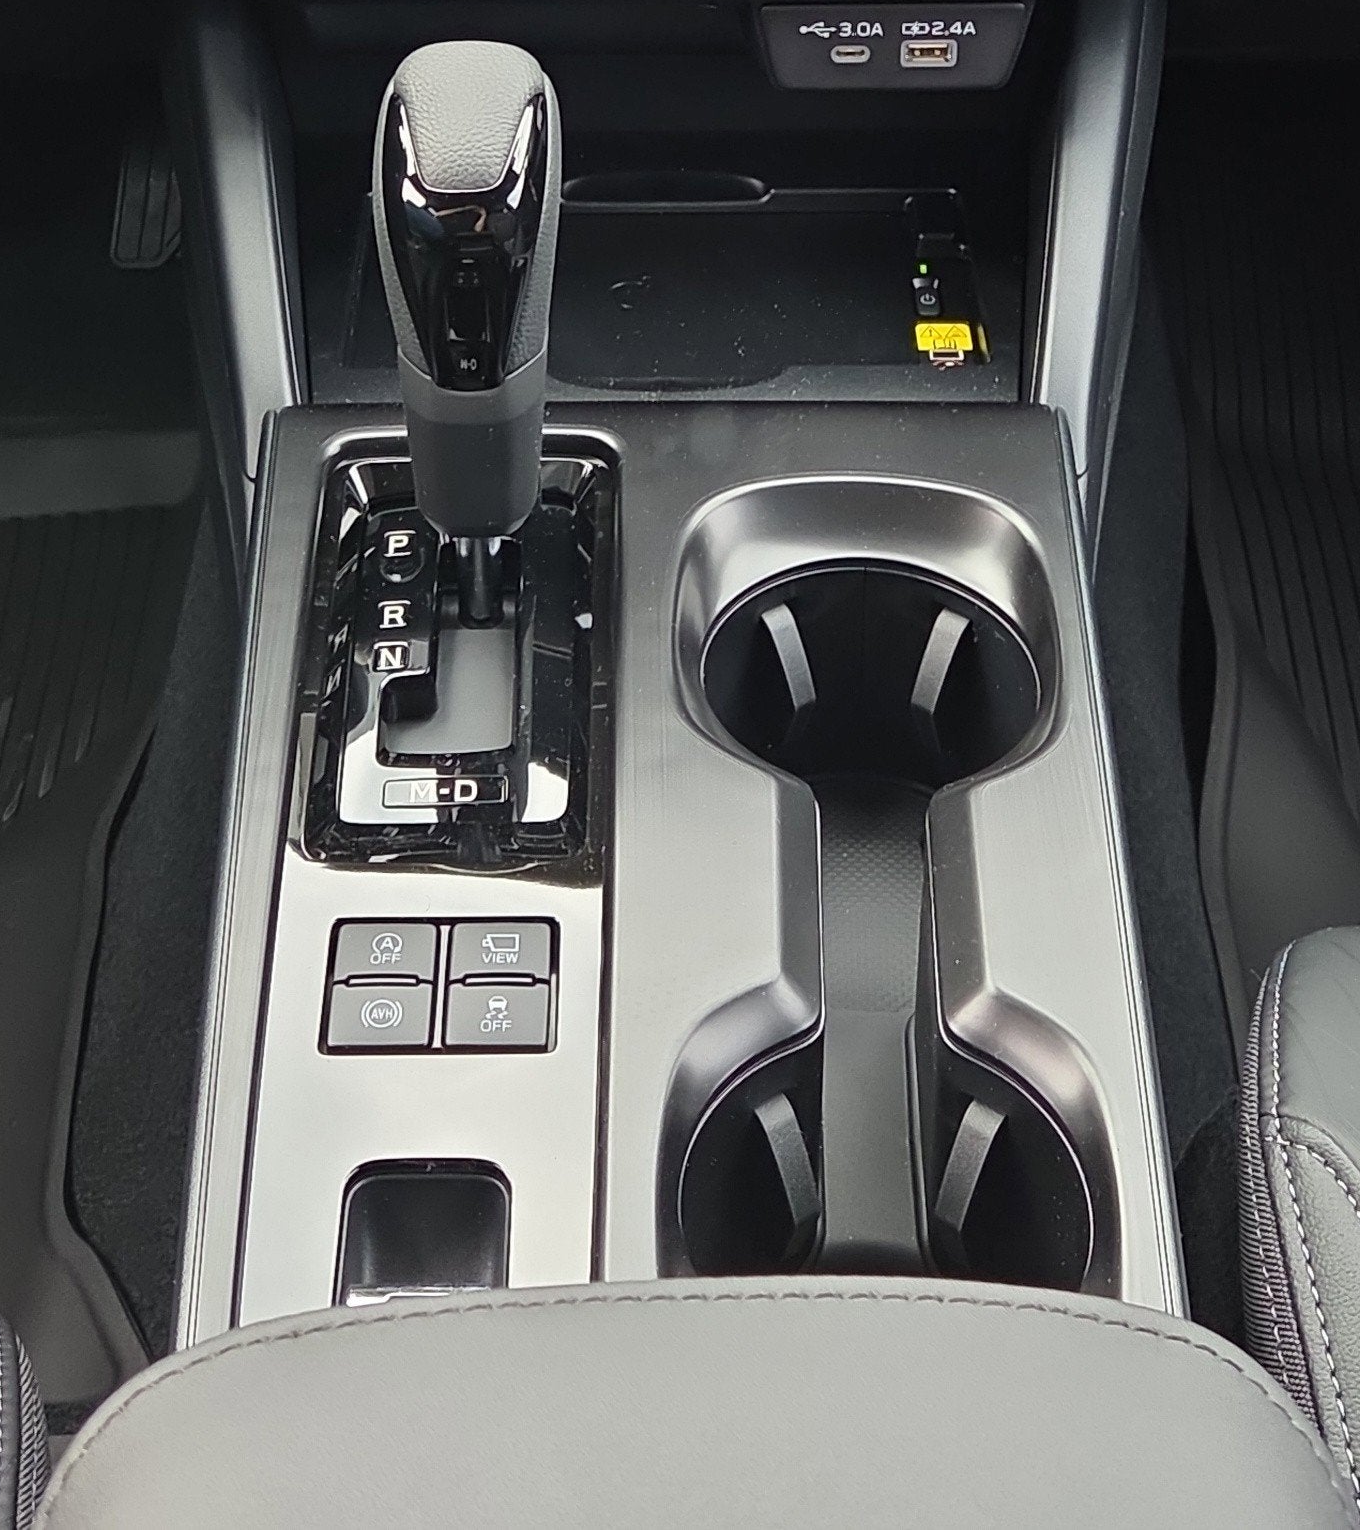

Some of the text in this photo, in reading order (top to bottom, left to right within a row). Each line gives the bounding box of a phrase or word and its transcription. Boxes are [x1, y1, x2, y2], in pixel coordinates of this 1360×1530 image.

[838, 21, 884, 38] 3.0A
[931, 21, 976, 37] 2.4A
[388, 535, 409, 553] P
[382, 606, 406, 624] R
[378, 647, 403, 667] N
[409, 779, 478, 803] M-D
[370, 952, 402, 965] OFF
[482, 952, 519, 965] VIEW
[370, 1007, 394, 1020] AVH
[480, 1020, 512, 1033] OFF
